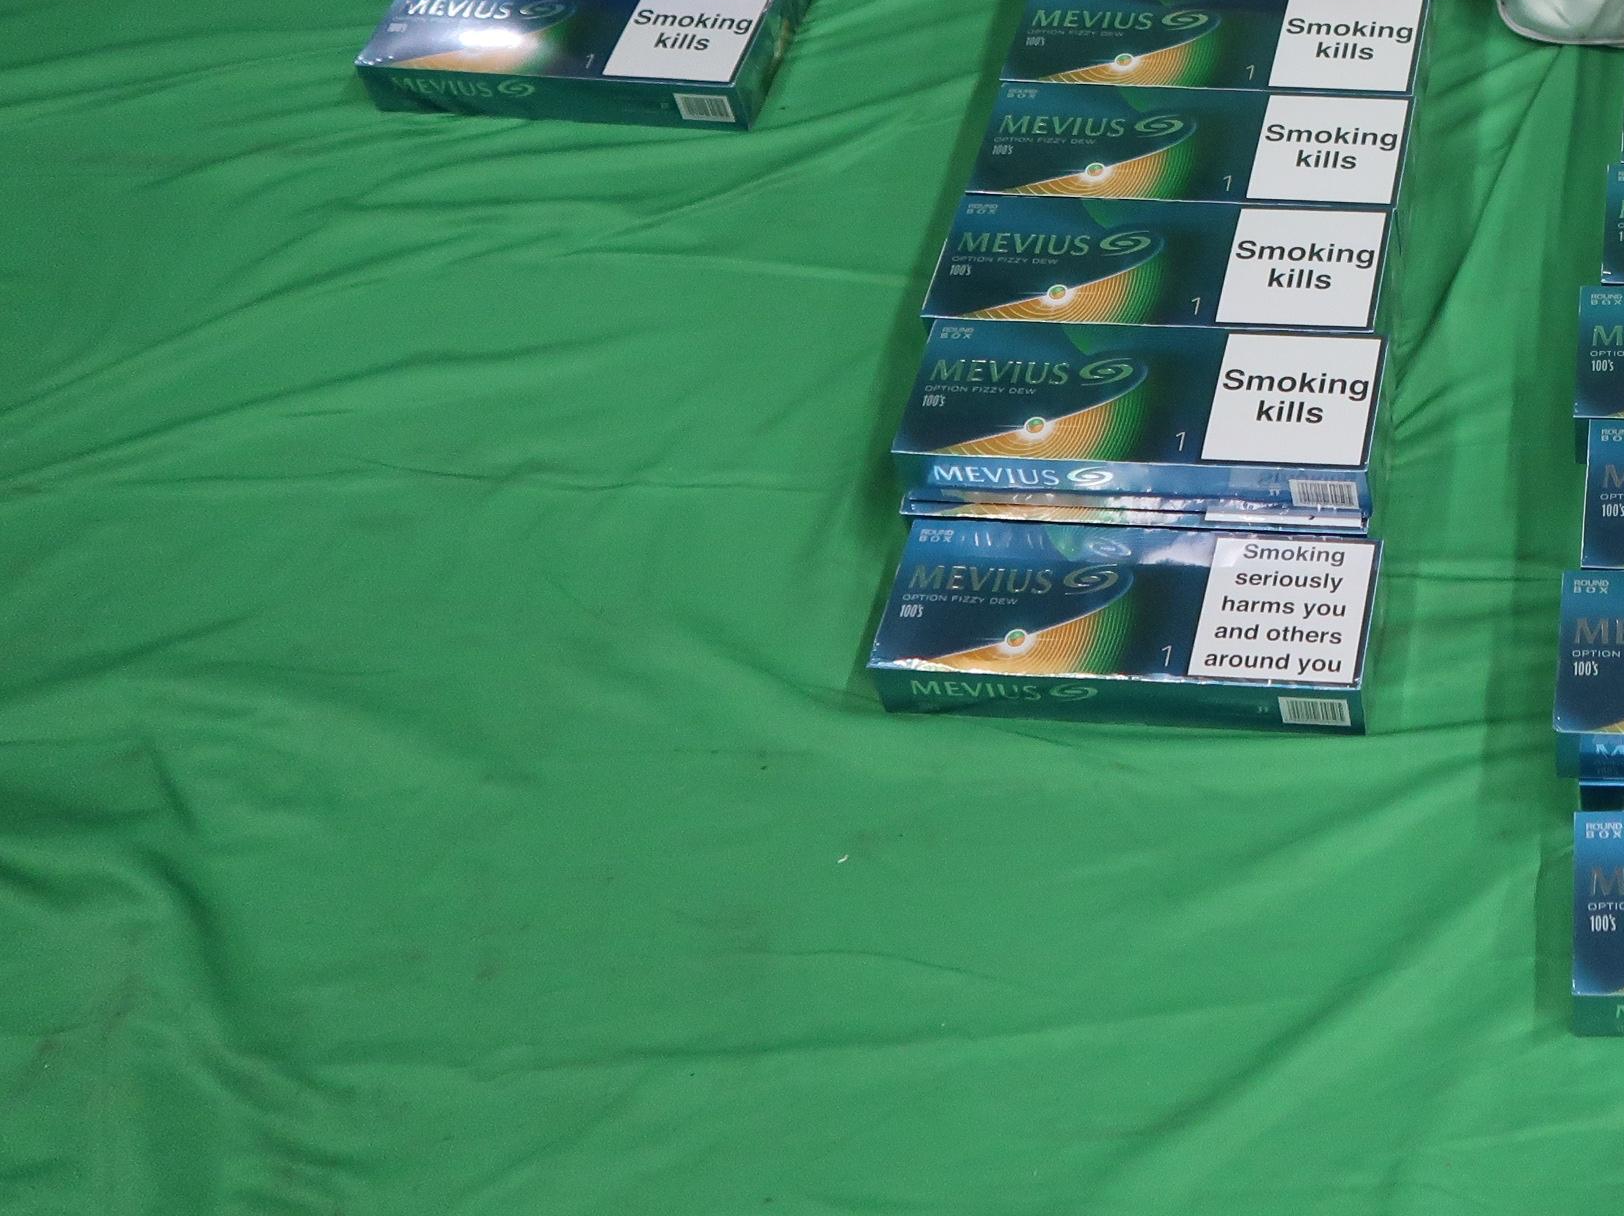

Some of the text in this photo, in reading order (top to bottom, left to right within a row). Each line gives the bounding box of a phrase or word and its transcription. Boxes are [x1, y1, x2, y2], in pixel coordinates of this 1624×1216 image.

[405, 0, 511, 20] MEVIUS
[1032, 9, 1154, 30] MEVIUS
[633, 8, 754, 36] Smoking
[1285, 17, 1414, 45] Smoking
[653, 31, 711, 51] kills
[1315, 41, 1374, 61] kills
[999, 115, 1126, 138] MEVIUS
[1264, 123, 1399, 152] Smoking
[1295, 149, 1357, 170] kills
[1223, 175, 1232, 192] 1
[958, 232, 1090, 256] MEVIUS
[1235, 239, 1376, 270] Smoking
[1267, 267, 1332, 290] kills
[929, 359, 1070, 384] MEVIUS
[1591, 360, 1613, 372] 100's
[1222, 368, 1370, 402] Smoking
[1255, 399, 1324, 425] kills
[933, 465, 1060, 485] MEVIUS
[1242, 543, 1346, 568] Smoking
[908, 566, 1052, 593] MEVIUS
[1234, 569, 1344, 594] seriously
[903, 593, 1018, 604] OPTION FIZZY DEW
[1220, 594, 1347, 620] harms you
[900, 604, 923, 617] 100's
[1213, 623, 1343, 645] and others
[1161, 645, 1172, 667] 1
[1203, 652, 1342, 676] around you
[1572, 650, 1621, 658] OPTION
[1573, 661, 1598, 676] 100's
[910, 680, 1043, 701] MEVIUS
[1590, 915, 1616, 931] 100's
